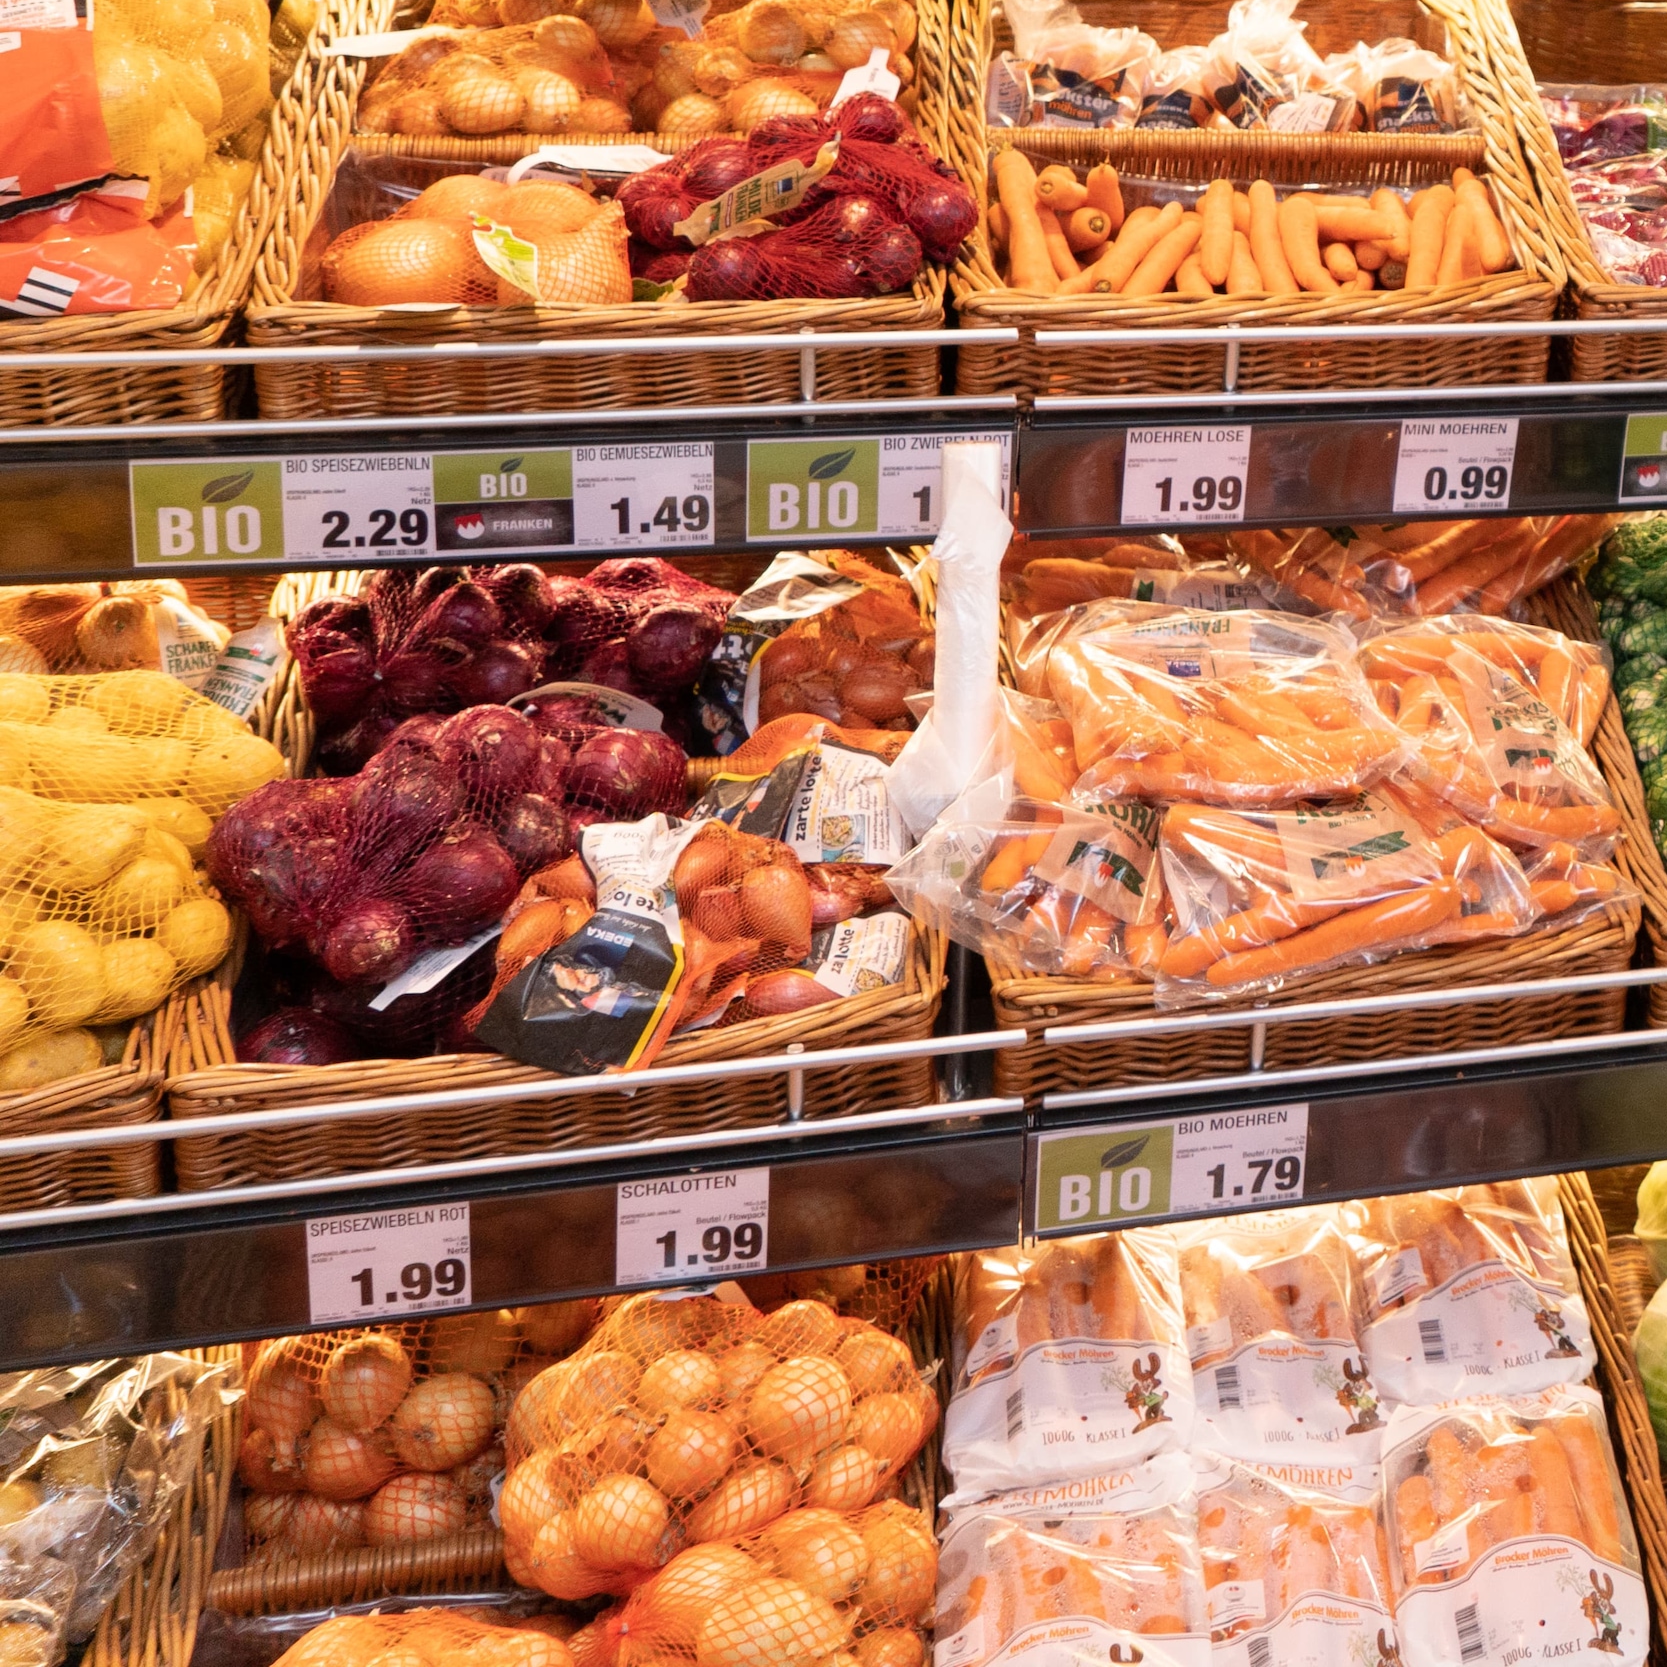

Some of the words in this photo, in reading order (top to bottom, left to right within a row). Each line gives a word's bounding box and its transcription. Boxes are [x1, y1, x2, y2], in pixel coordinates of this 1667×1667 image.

[884, 437, 907, 451] BIO
[1130, 431, 1203, 444] MOEHREN
[1207, 429, 1245, 443] LOSE
[1404, 424, 1435, 436] MINI
[1439, 422, 1508, 436] MOEHREN
[286, 459, 308, 474] BIO
[312, 456, 431, 473] SPEISEZWIEBENLN
[576, 447, 597, 462] BIO
[600, 444, 714, 462] GEMUESEZWIEBELN
[479, 472, 528, 499] BIO
[1155, 476, 1242, 512] 1.99
[1424, 466, 1509, 500] 0.99
[610, 495, 710, 535] 1.49
[768, 481, 860, 531] BIO
[157, 505, 262, 557] BIO
[321, 508, 430, 549] 2.29
[493, 518, 553, 532] FRANKEN
[1179, 1119, 1204, 1135] BIO
[1210, 1110, 1288, 1131] MOEHREN
[621, 1174, 737, 1199] SCHALOTTEN
[1059, 1166, 1152, 1221] BIO
[1207, 1156, 1300, 1199] 1.79
[311, 1210, 436, 1237] SPEISEZWIEBELN
[440, 1207, 466, 1221] ROT
[656, 1222, 763, 1268] 1.99
[352, 1258, 465, 1306] 1.99
